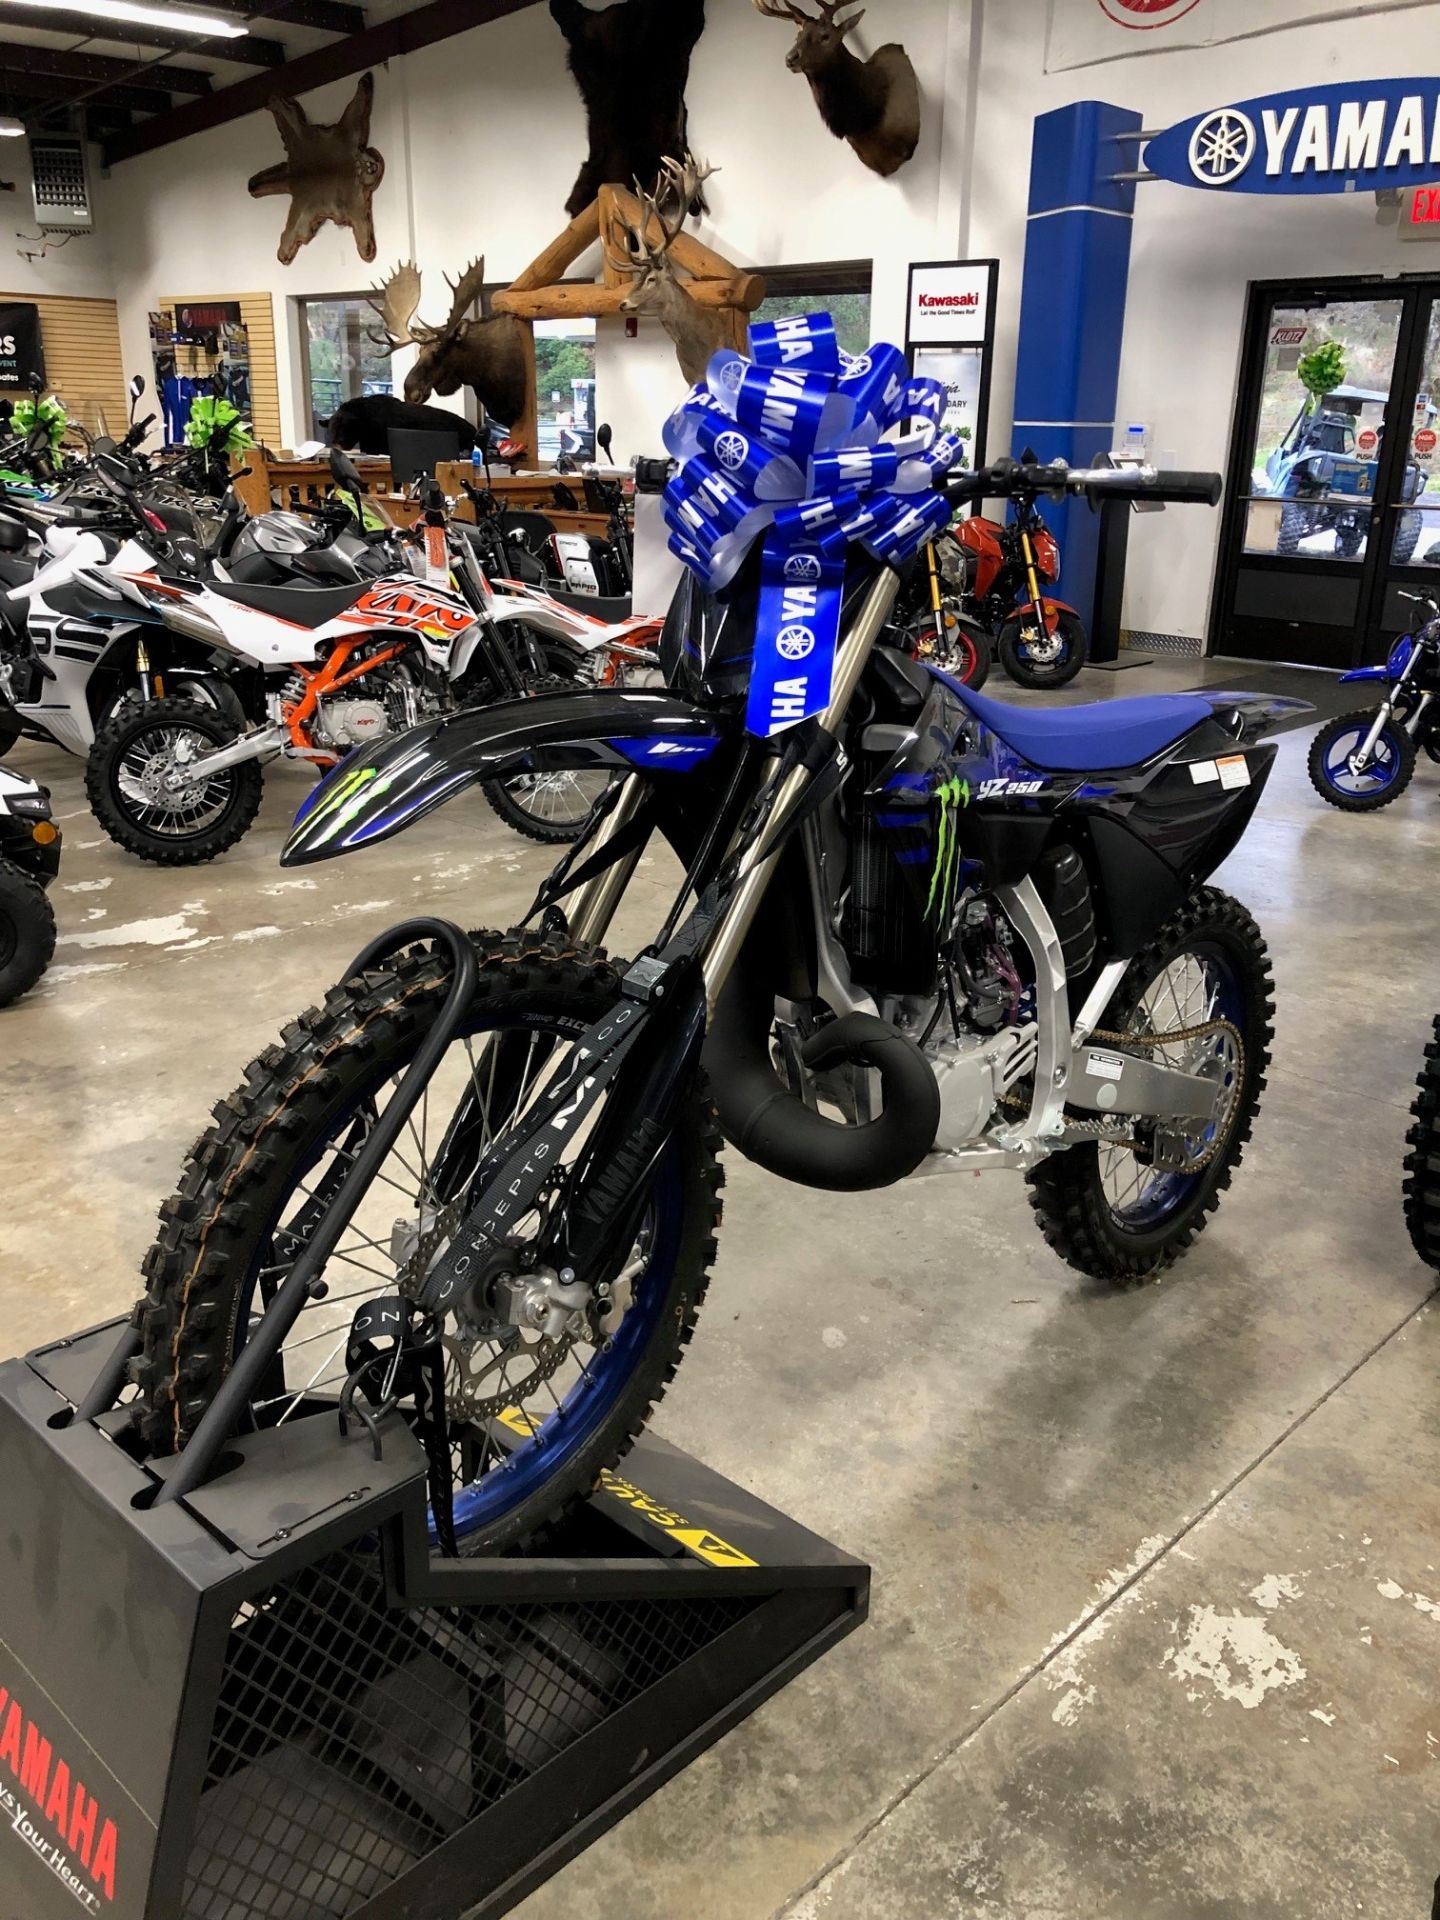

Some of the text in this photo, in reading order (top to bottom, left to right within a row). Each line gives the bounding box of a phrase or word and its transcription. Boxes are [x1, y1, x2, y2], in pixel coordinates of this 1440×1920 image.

[919, 292, 979, 307] Kawasaki
[556, 1015, 593, 1033] EXCE
[282, 1166, 350, 1256] MATRIX
[578, 1117, 661, 1225] YAMAHA
[11, 1803, 54, 1854] Your
[49, 1847, 97, 1906] Heart
